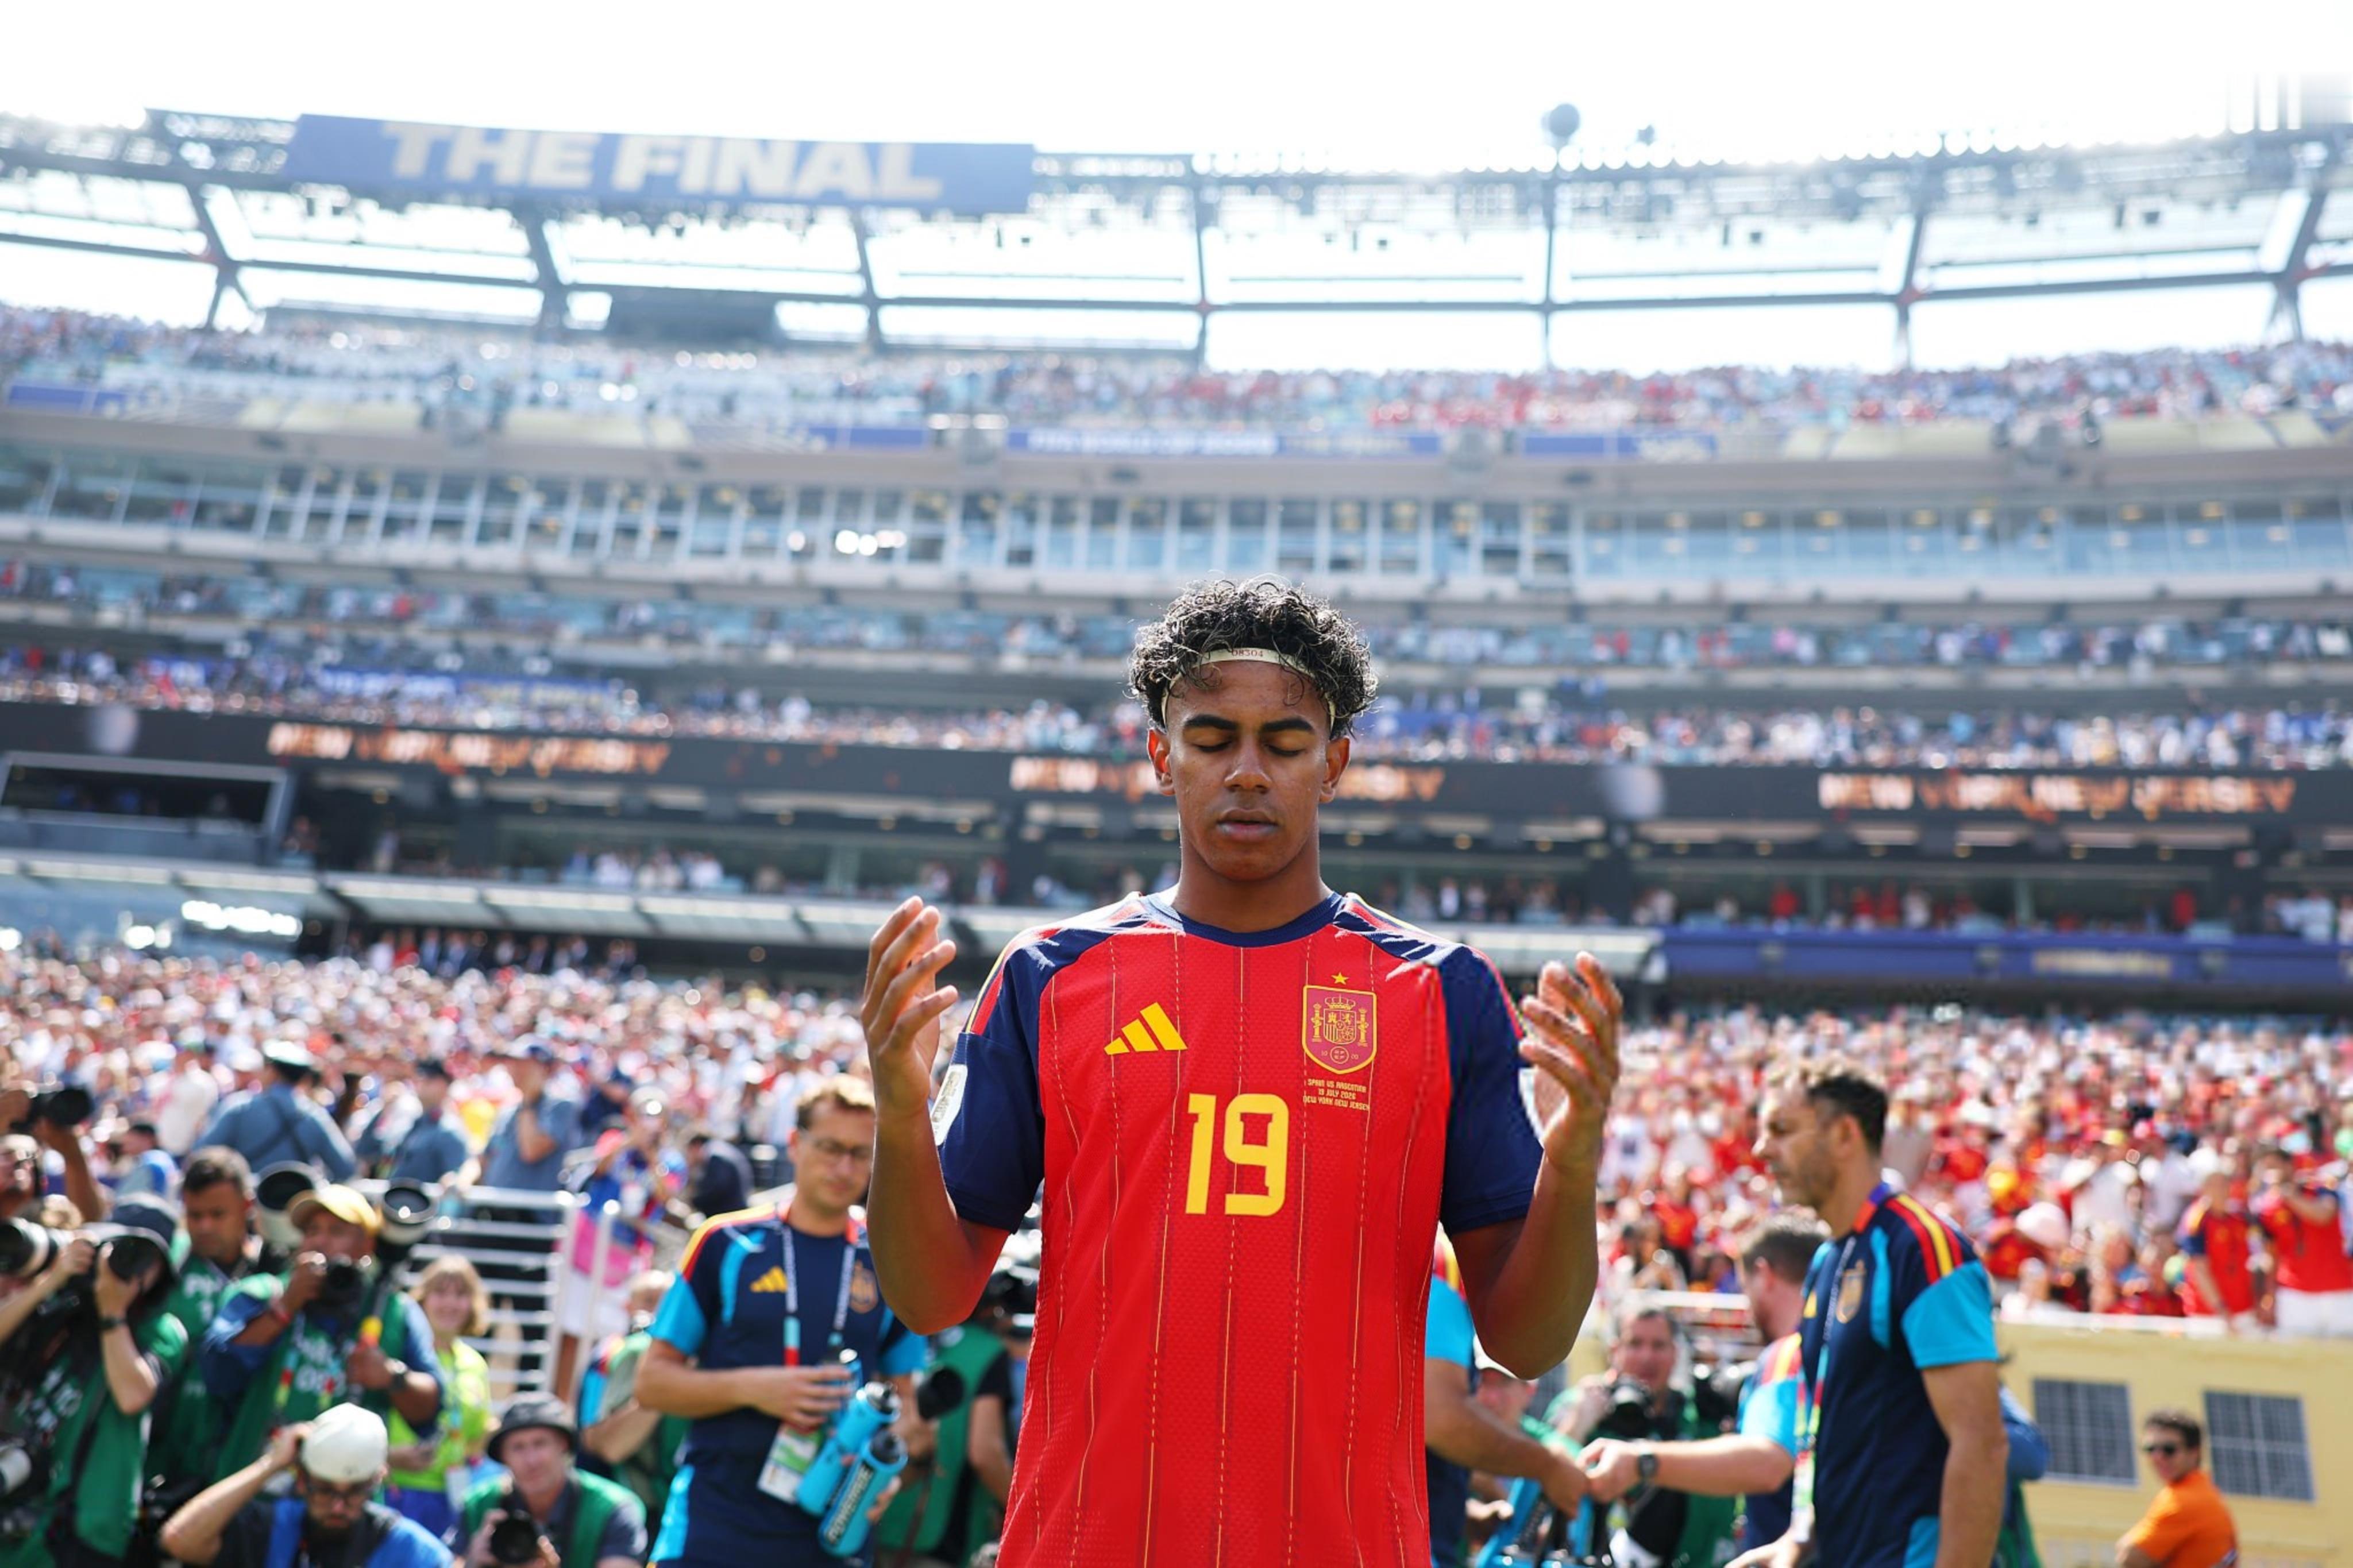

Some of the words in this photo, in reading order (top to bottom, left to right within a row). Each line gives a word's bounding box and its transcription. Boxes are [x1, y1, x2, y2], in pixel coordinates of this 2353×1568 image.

[382, 120, 601, 188] THE
[611, 135, 943, 199] FINAL
[1818, 774, 1914, 810] NEW
[2032, 775, 2130, 811] NEW
[2132, 775, 2296, 813] JERSEY
[1303, 1095, 1317, 1103] NEW
[1318, 1097, 1333, 1106] YORK
[1334, 1099, 1349, 1107] NEW
[1350, 1102, 1370, 1110] JERSEY
[1307, 1079, 1325, 1087] SPAIN
[1326, 1089, 1340, 1097] JULY
[1340, 1091, 1356, 1100] 2026
[1185, 1093, 1289, 1216] 19
[826, 1465, 875, 1544] POWERADE
